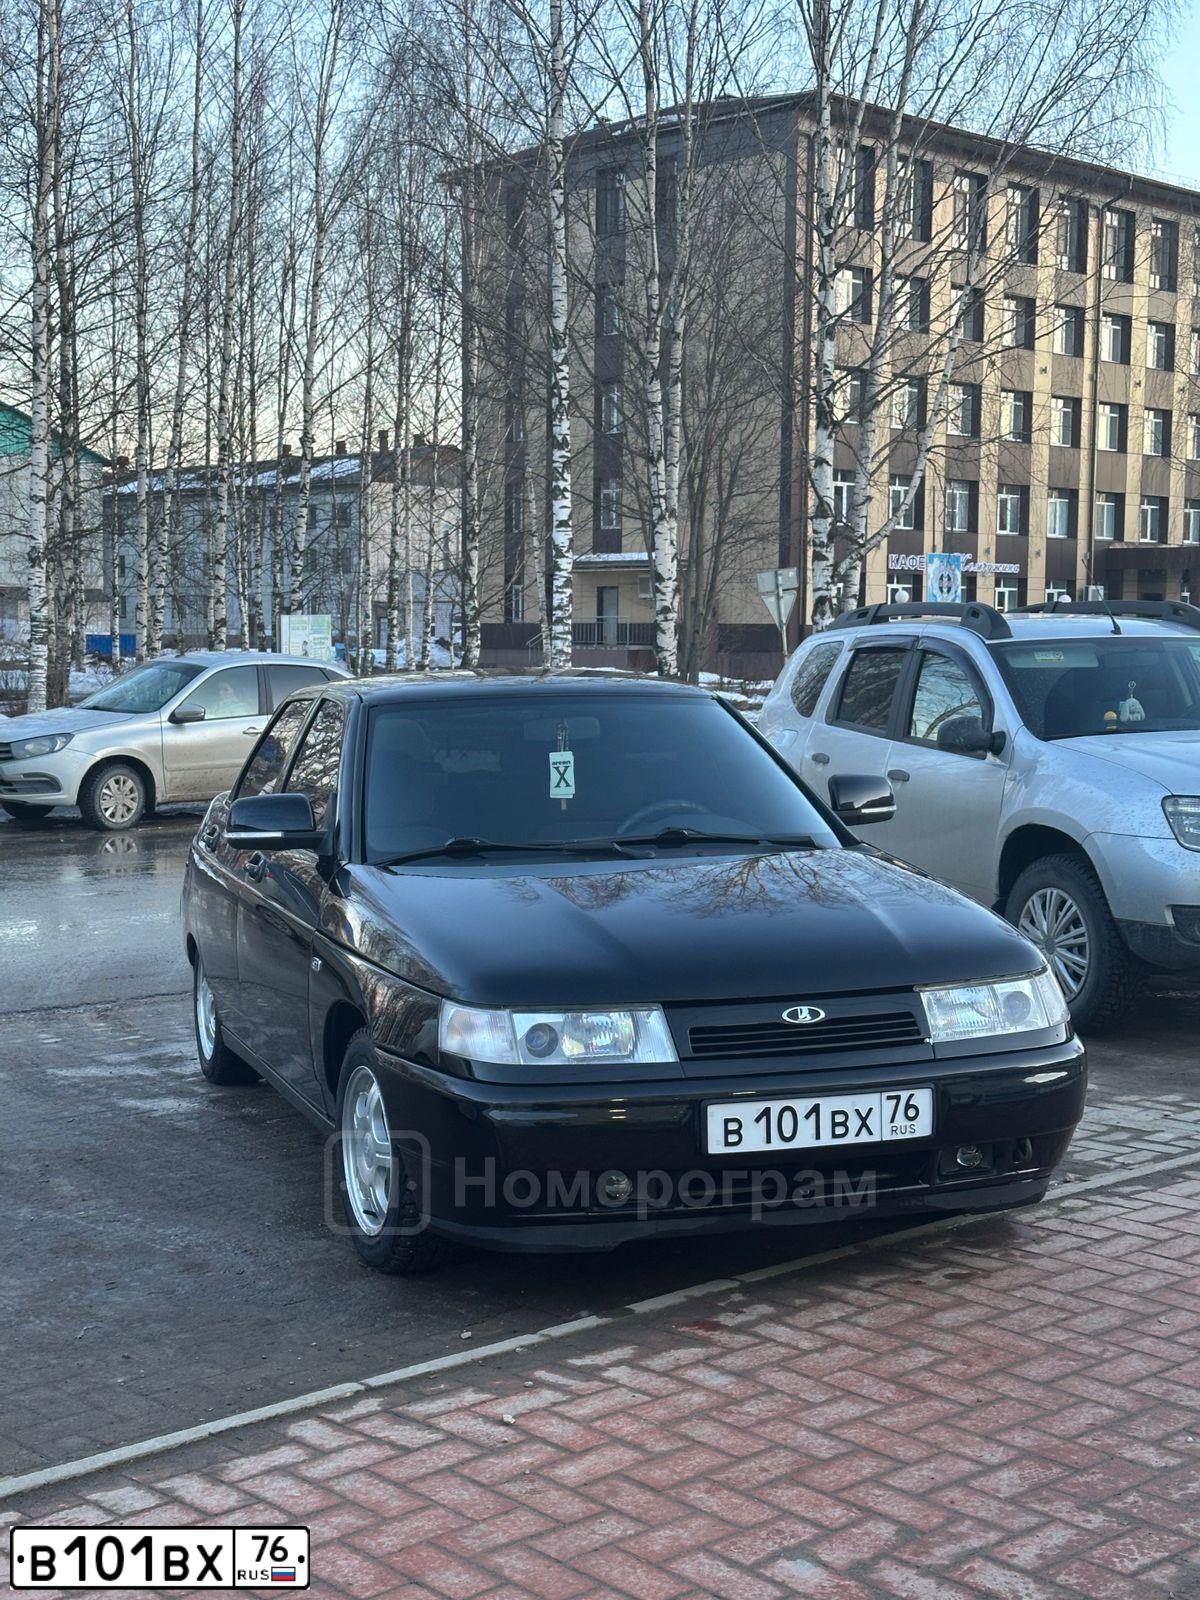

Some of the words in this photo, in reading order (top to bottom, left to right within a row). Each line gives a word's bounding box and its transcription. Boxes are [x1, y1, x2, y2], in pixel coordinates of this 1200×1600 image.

[888, 554, 926, 571] КАФЕ
[552, 766, 572, 788] X
[723, 1103, 874, 1147] В101ВХ
[886, 1093, 920, 1124] 76
[890, 1123, 917, 1136] RUS
